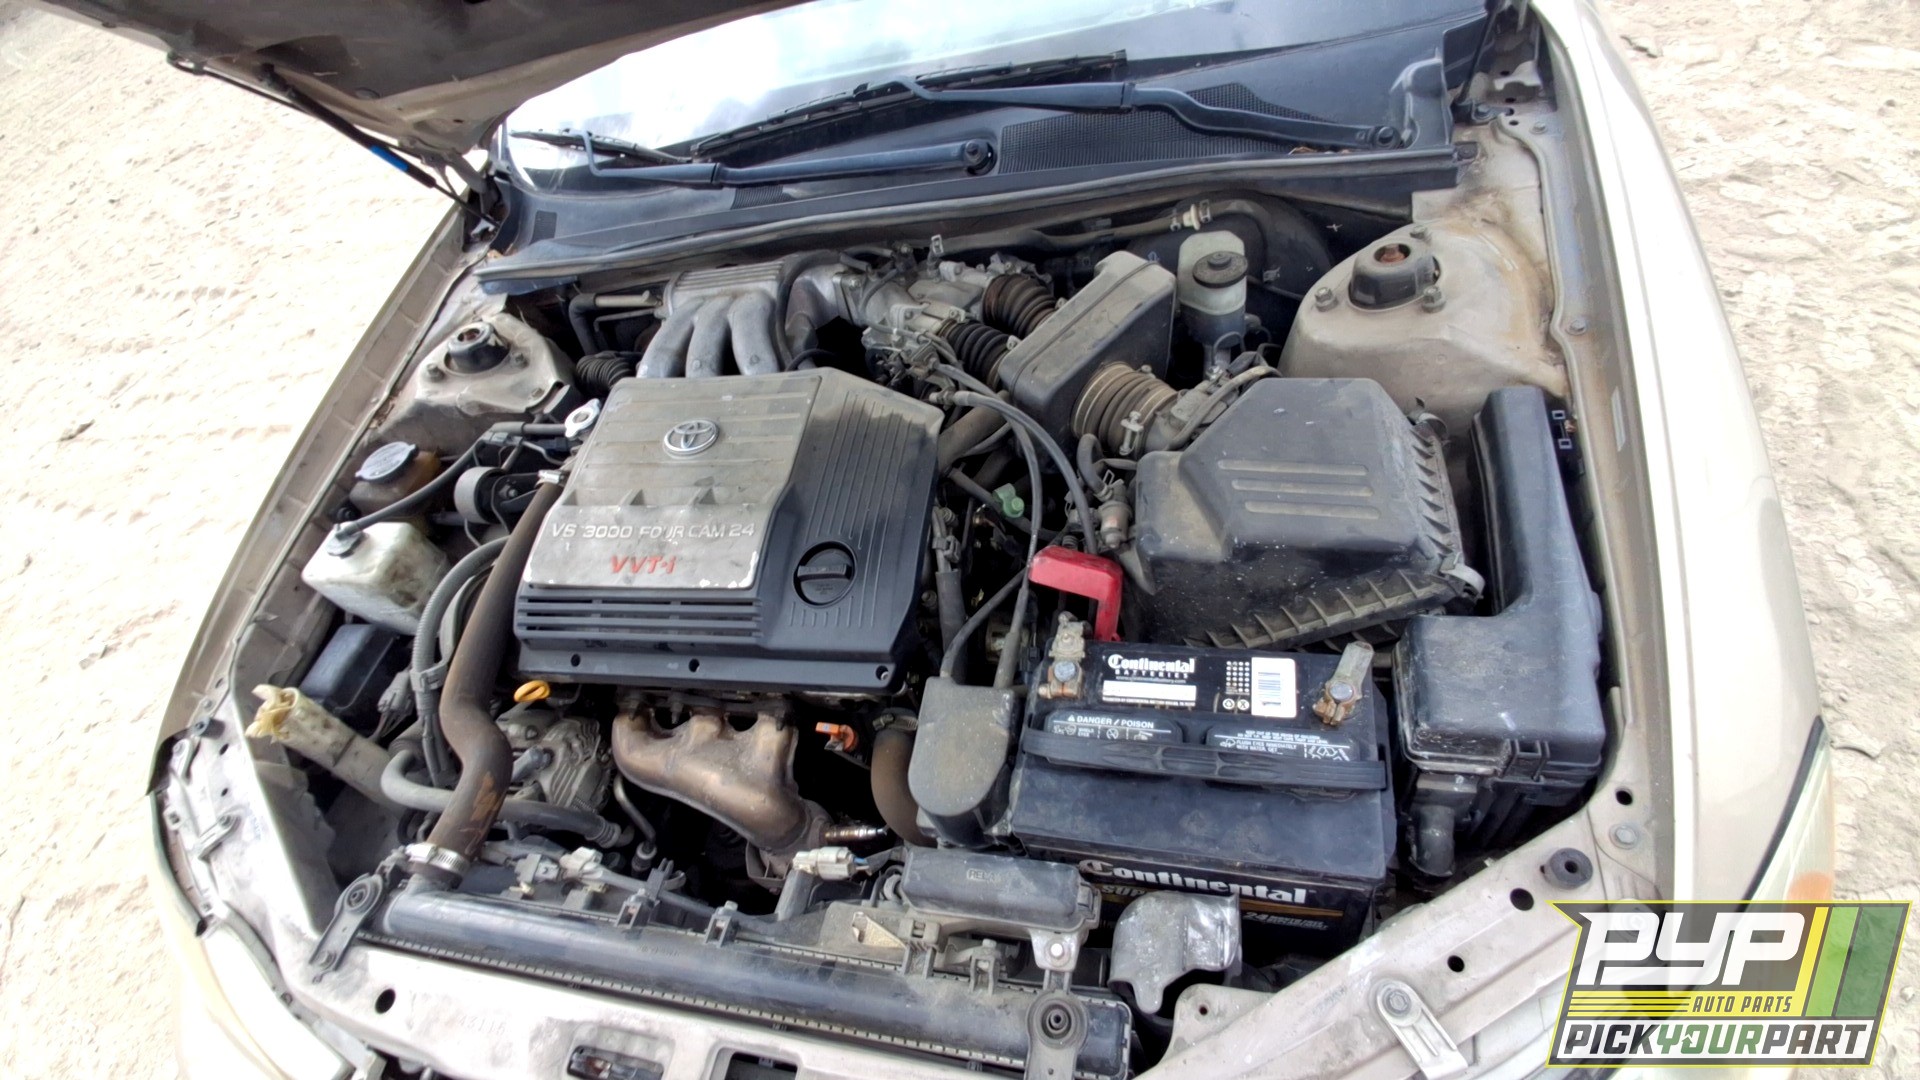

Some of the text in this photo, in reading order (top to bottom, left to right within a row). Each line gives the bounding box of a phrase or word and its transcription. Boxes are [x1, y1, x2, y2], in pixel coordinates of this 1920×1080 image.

[552, 523, 755, 539] V6 3000 FOUR CAM 24
[1107, 654, 1195, 673] Continental
[1115, 669, 1188, 679] BATTERIES
[1076, 715, 1112, 725] DANGER
[1121, 719, 1154, 729] POISON
[1078, 859, 1307, 904] Continental
